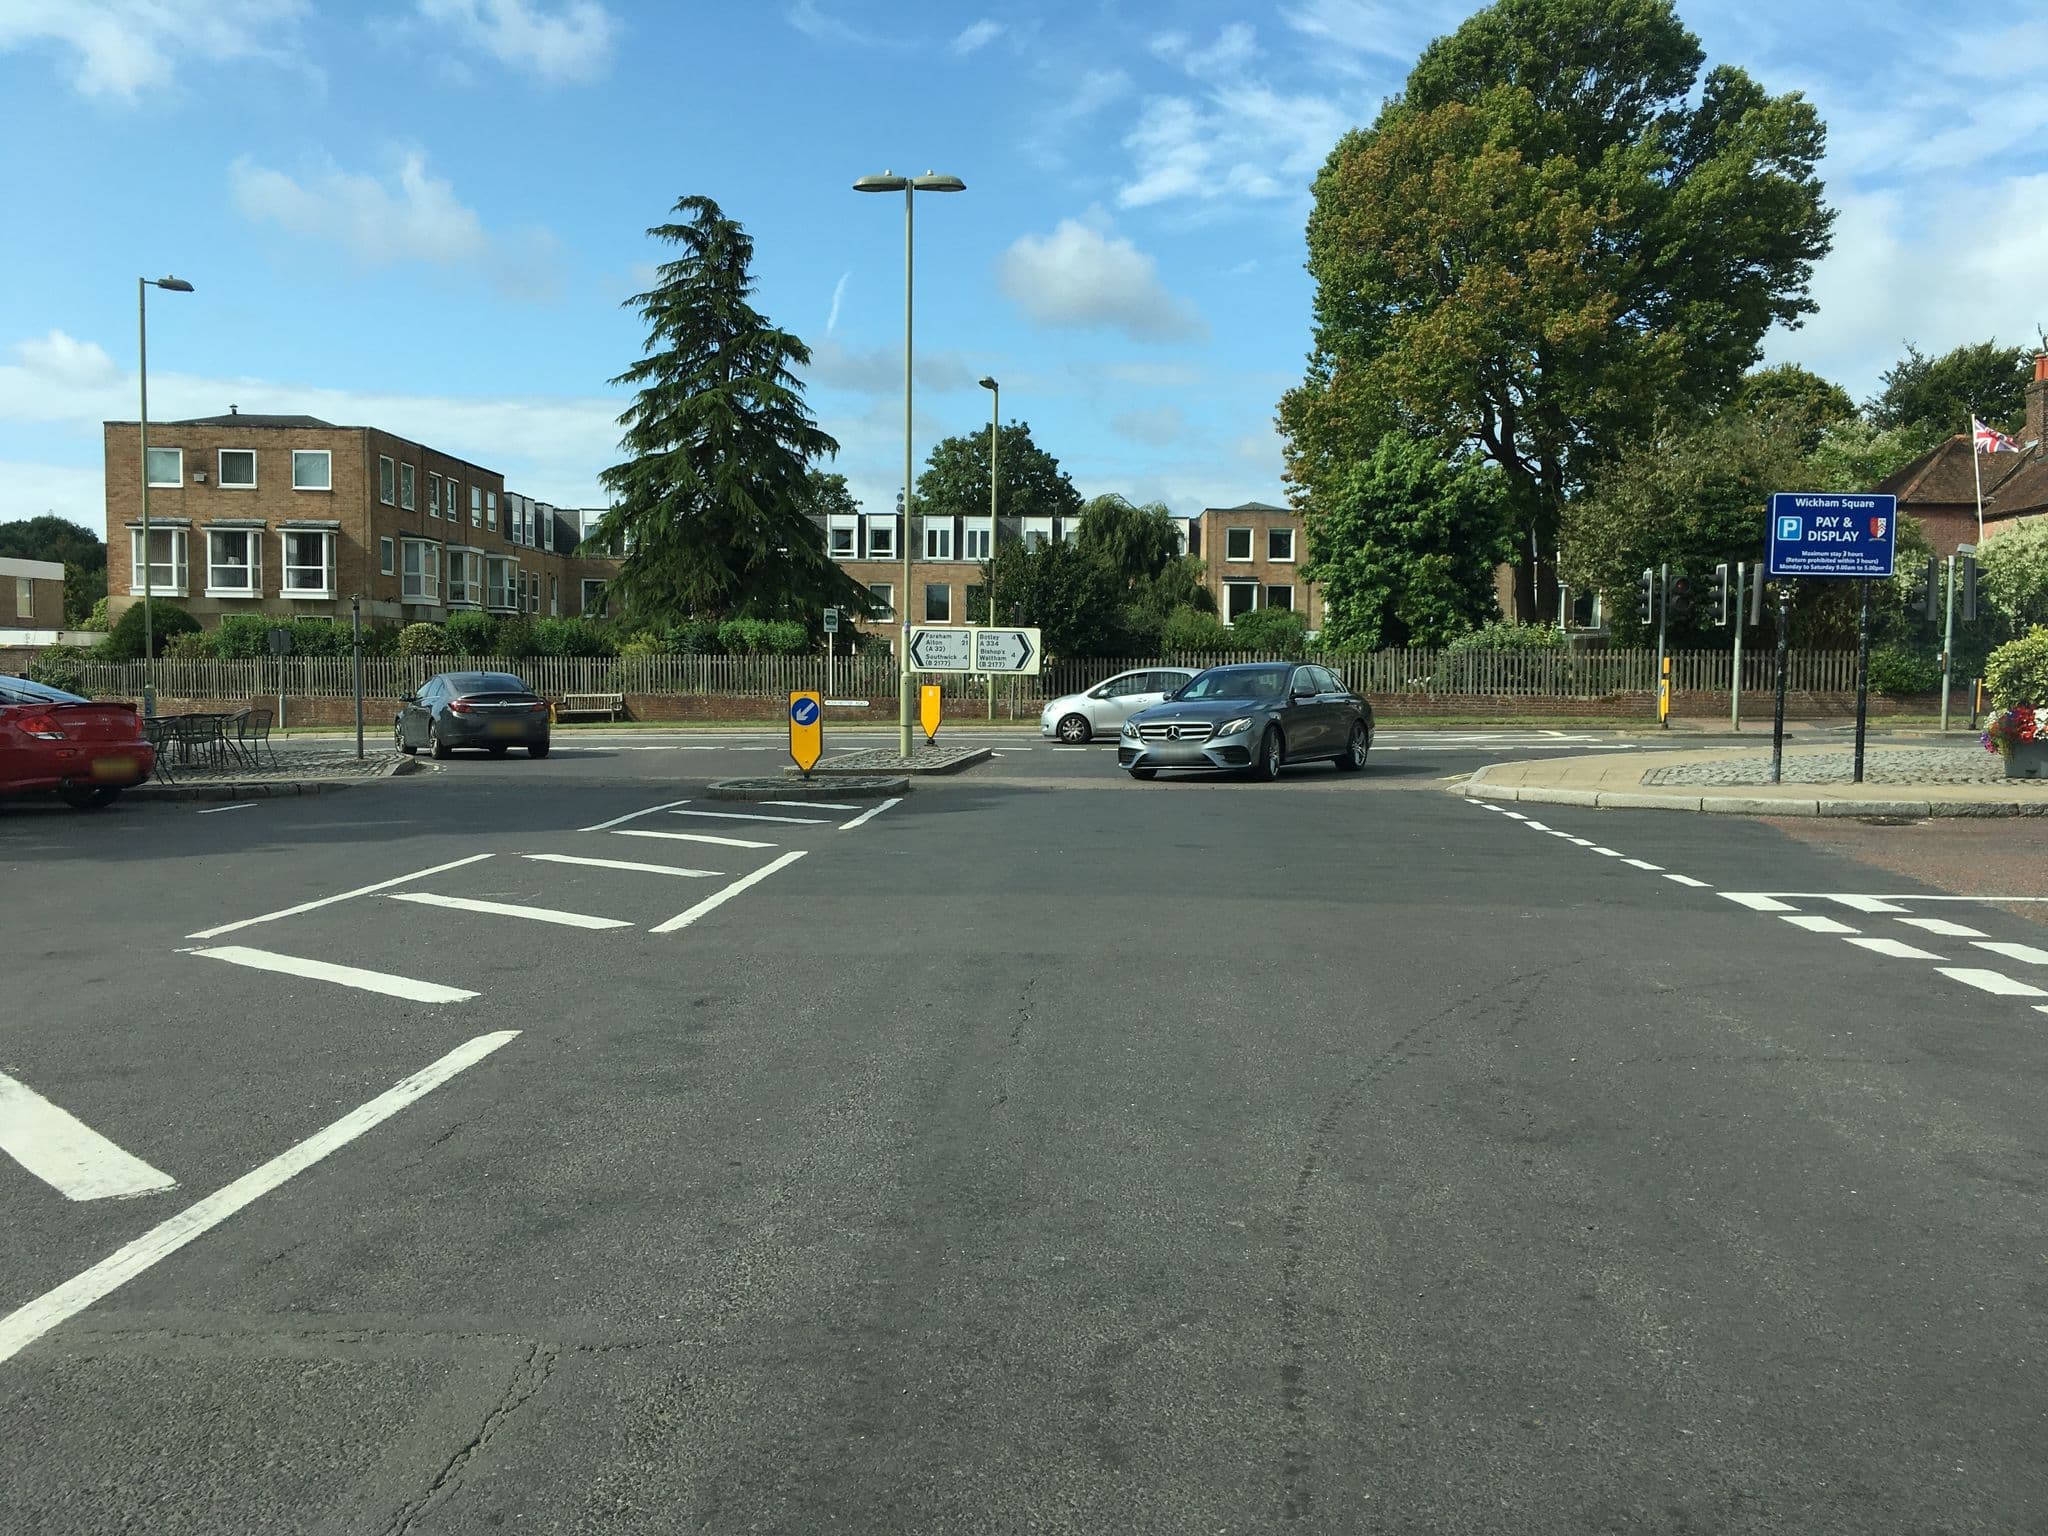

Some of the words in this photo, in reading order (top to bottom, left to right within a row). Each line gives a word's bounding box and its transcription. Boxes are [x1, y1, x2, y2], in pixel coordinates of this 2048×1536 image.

[1795, 498, 1839, 508] Wickham
[1841, 499, 1875, 509] Square
[1816, 517, 1839, 527] PAY
[1843, 517, 1853, 527] &
[1782, 519, 1798, 538] P
[1808, 531, 1859, 541] DISPLAY
[1807, 557, 1837, 565] prohibited
[1861, 558, 1879, 566] hours)
[1779, 564, 1802, 572] Monday
[1810, 564, 1836, 572] Saturday
